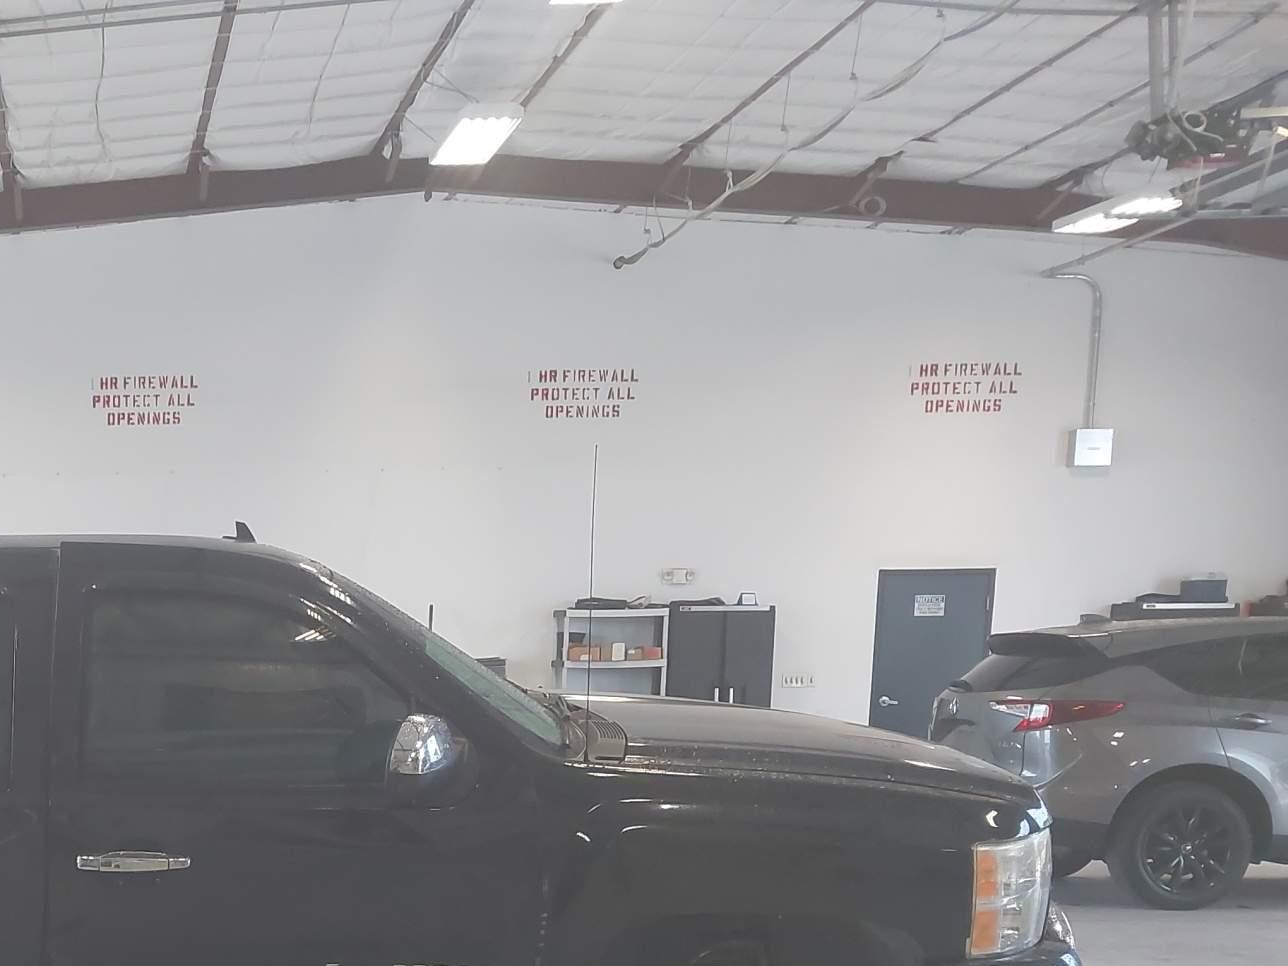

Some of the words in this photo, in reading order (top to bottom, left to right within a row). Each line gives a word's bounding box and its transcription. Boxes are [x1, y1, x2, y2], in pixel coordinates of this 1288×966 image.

[539, 369, 557, 383] HR
[563, 368, 639, 383] FIREWALL
[919, 363, 939, 377] HR
[944, 362, 1022, 377] FIREWALL
[100, 376, 118, 390] HR
[123, 375, 198, 390] FIREWALL
[911, 381, 982, 395] PROTECT
[989, 380, 1017, 394] ALL
[92, 394, 160, 408] PROTECT
[168, 393, 195, 407] ALL
[530, 387, 600, 401] PROTECT
[608, 386, 635, 400] ALL
[545, 404, 620, 418] OPENINGS
[925, 398, 1001, 413] OPENINGS
[107, 411, 181, 426] OPENINGS
